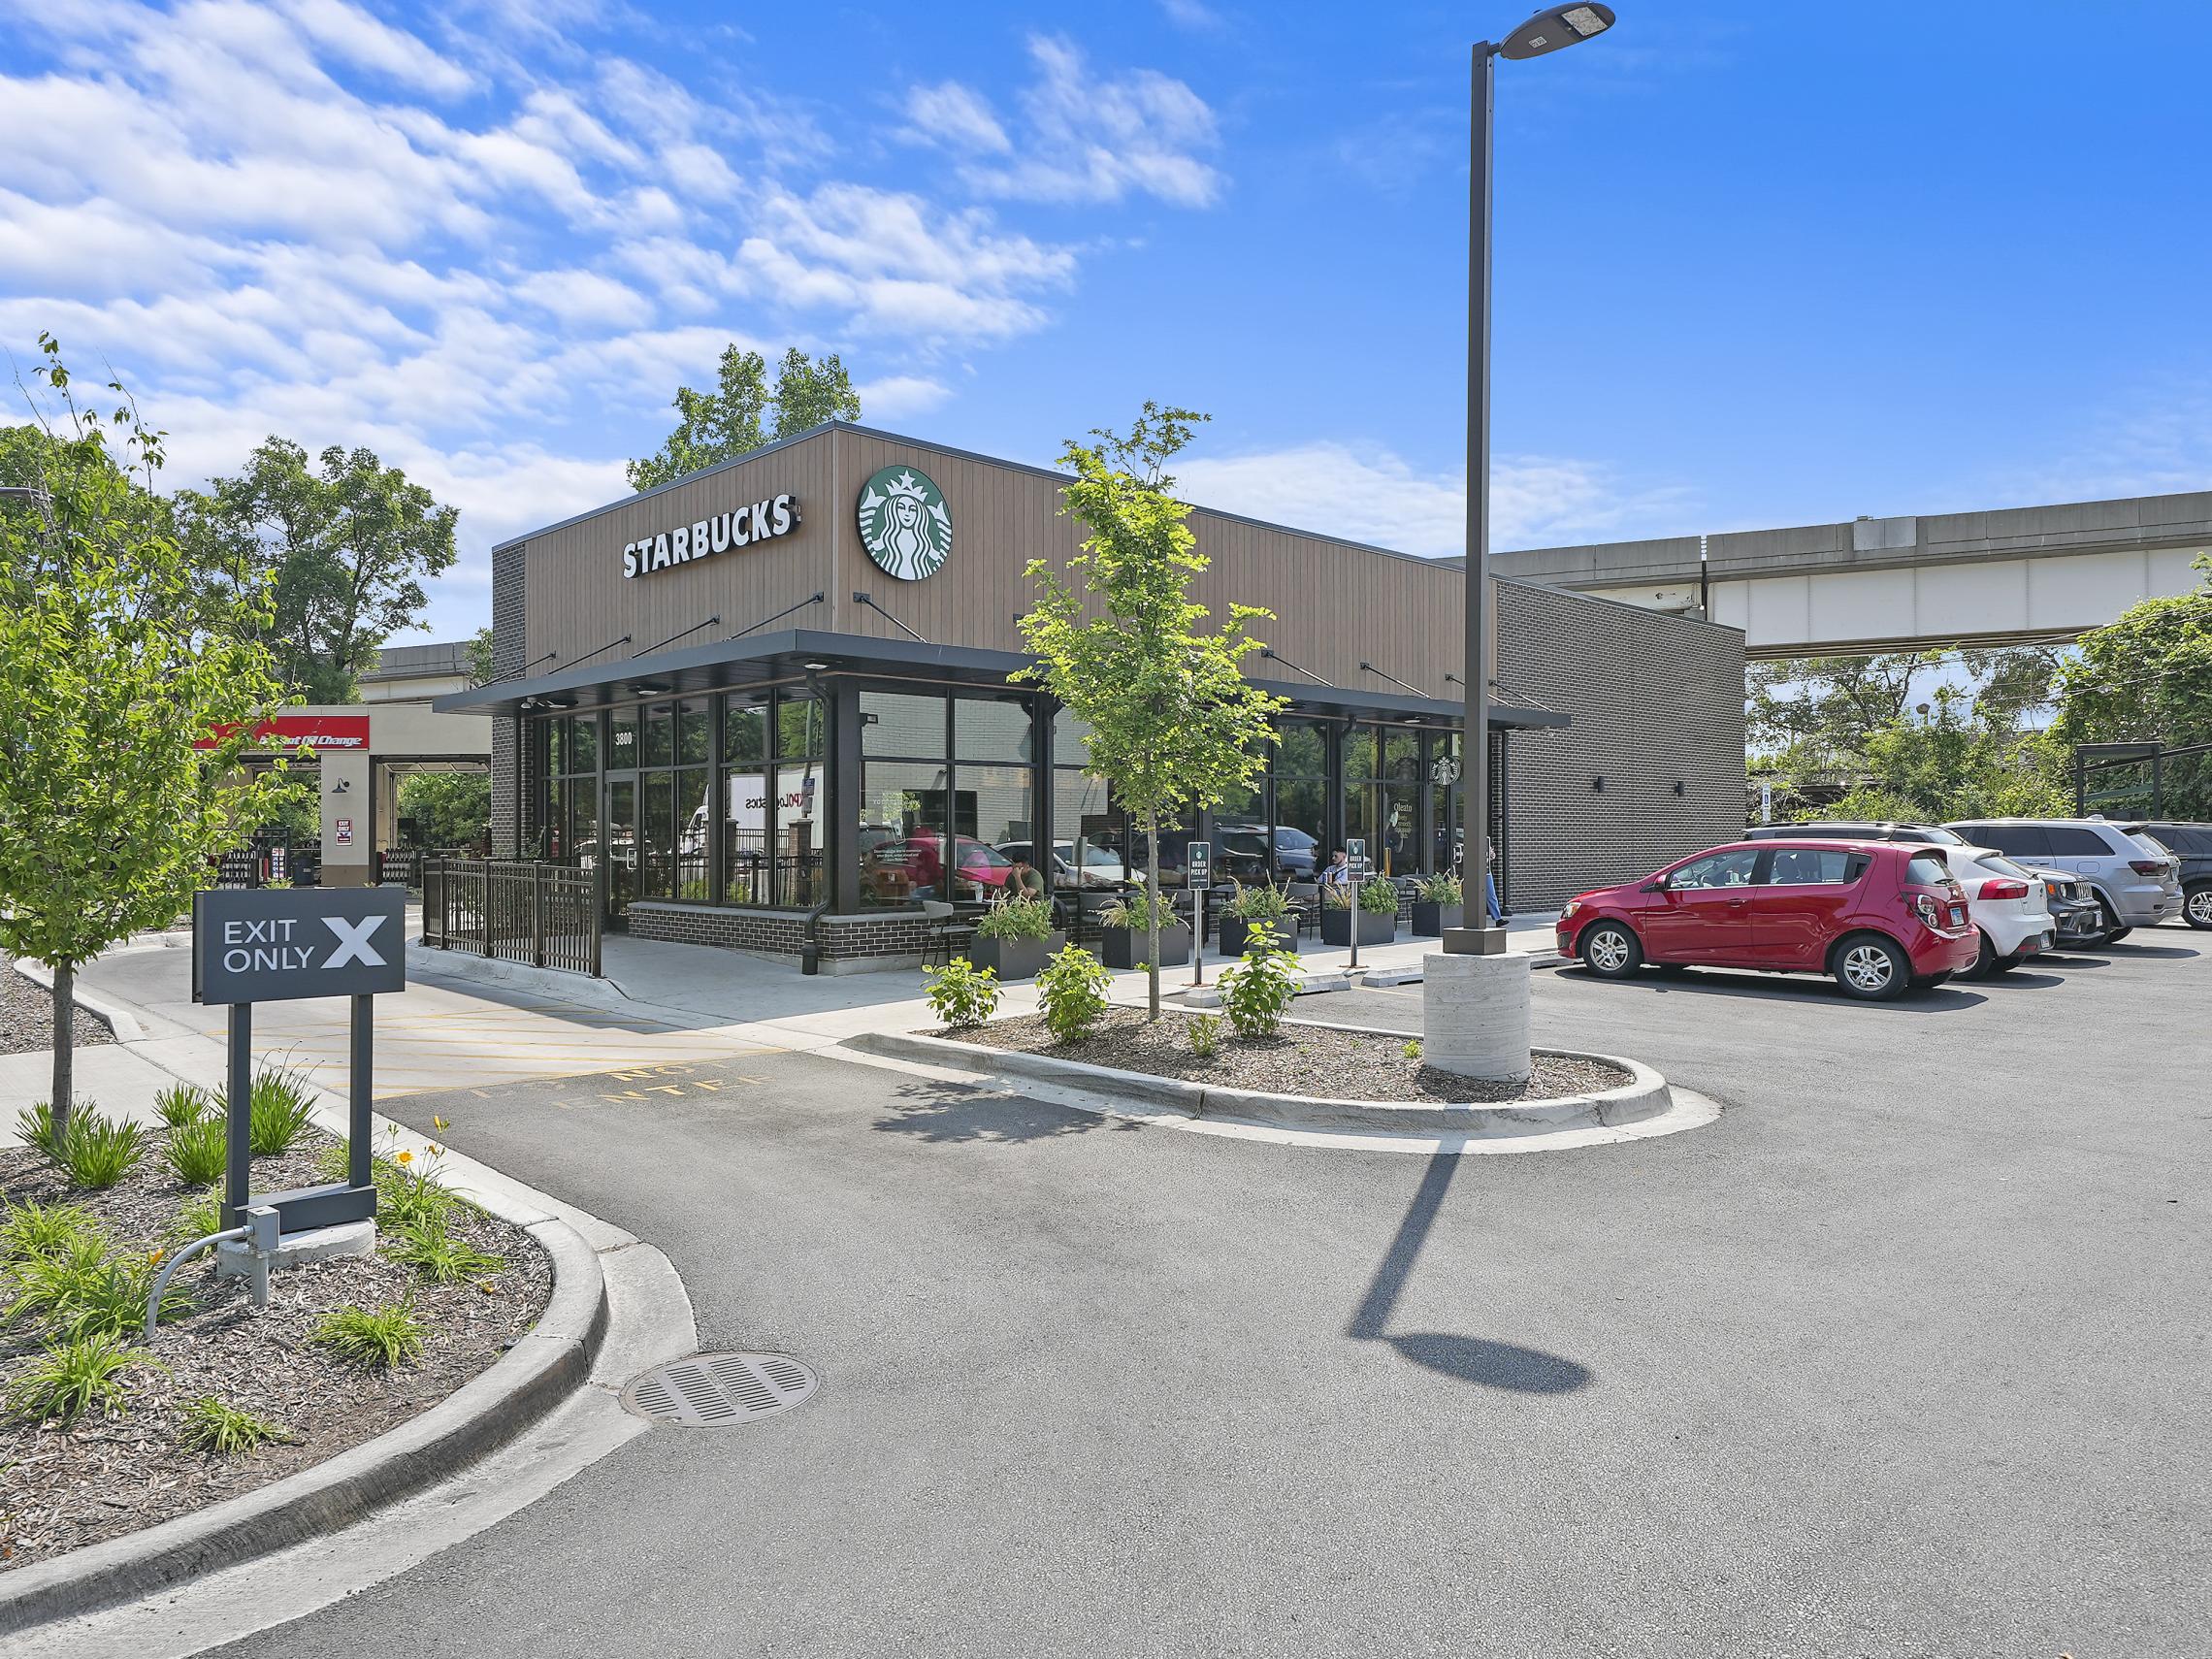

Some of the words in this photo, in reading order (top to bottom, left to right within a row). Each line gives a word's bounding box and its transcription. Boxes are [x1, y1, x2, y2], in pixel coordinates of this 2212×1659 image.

[623, 494, 792, 578] STARBUCKS
[318, 735, 363, 747] Change
[615, 732, 633, 746] 3800
[224, 919, 298, 945] EXIT
[223, 946, 315, 973] ONLY
